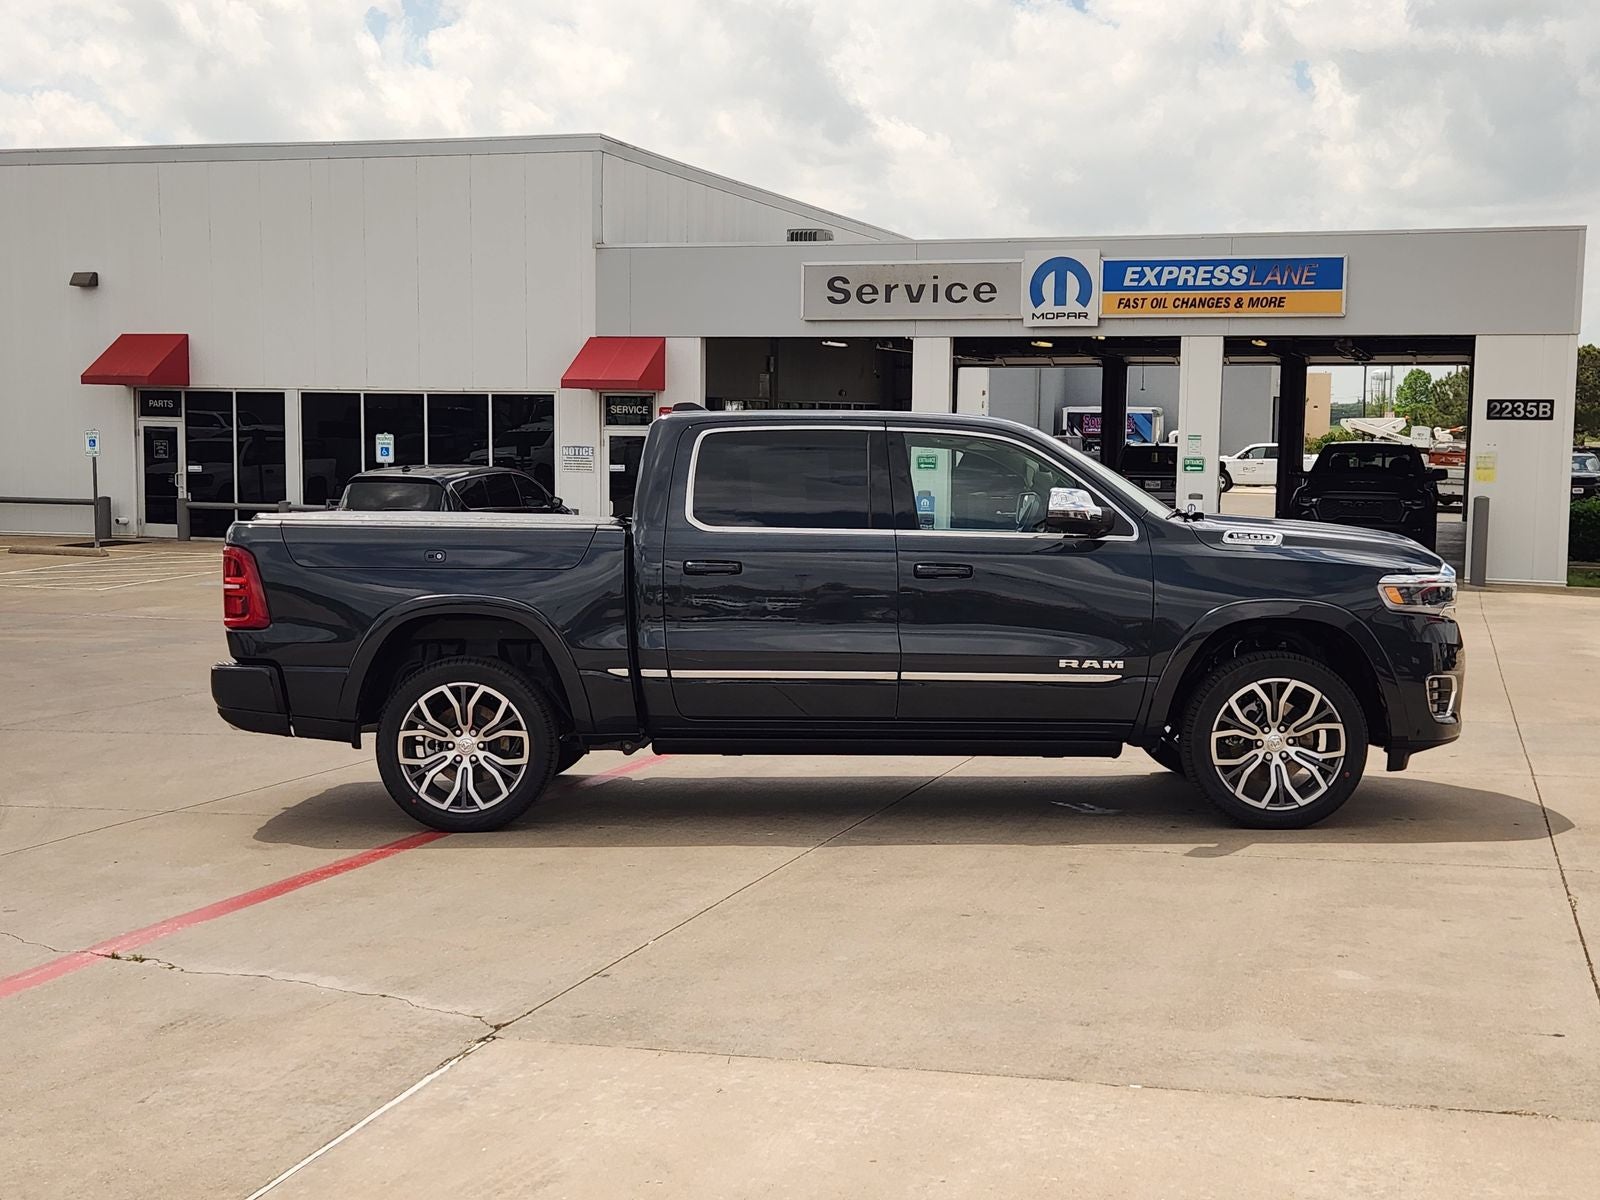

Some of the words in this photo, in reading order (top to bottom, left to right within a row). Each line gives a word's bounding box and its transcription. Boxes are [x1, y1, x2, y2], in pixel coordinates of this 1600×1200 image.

[826, 275, 998, 305] Service
[1117, 297, 1147, 310] FAST
[1150, 297, 1169, 309] OIL
[1172, 297, 1231, 309] CHANGES
[1234, 297, 1244, 309] &
[1247, 296, 1287, 309] MORE
[1031, 312, 1089, 320] MOPAR
[148, 400, 174, 408] PARTS
[610, 405, 649, 414] SERVICE
[1489, 402, 1552, 418] 2235B
[562, 447, 594, 456] NOTICE
[1230, 532, 1276, 541] 1500
[1058, 660, 1124, 669] RAM
